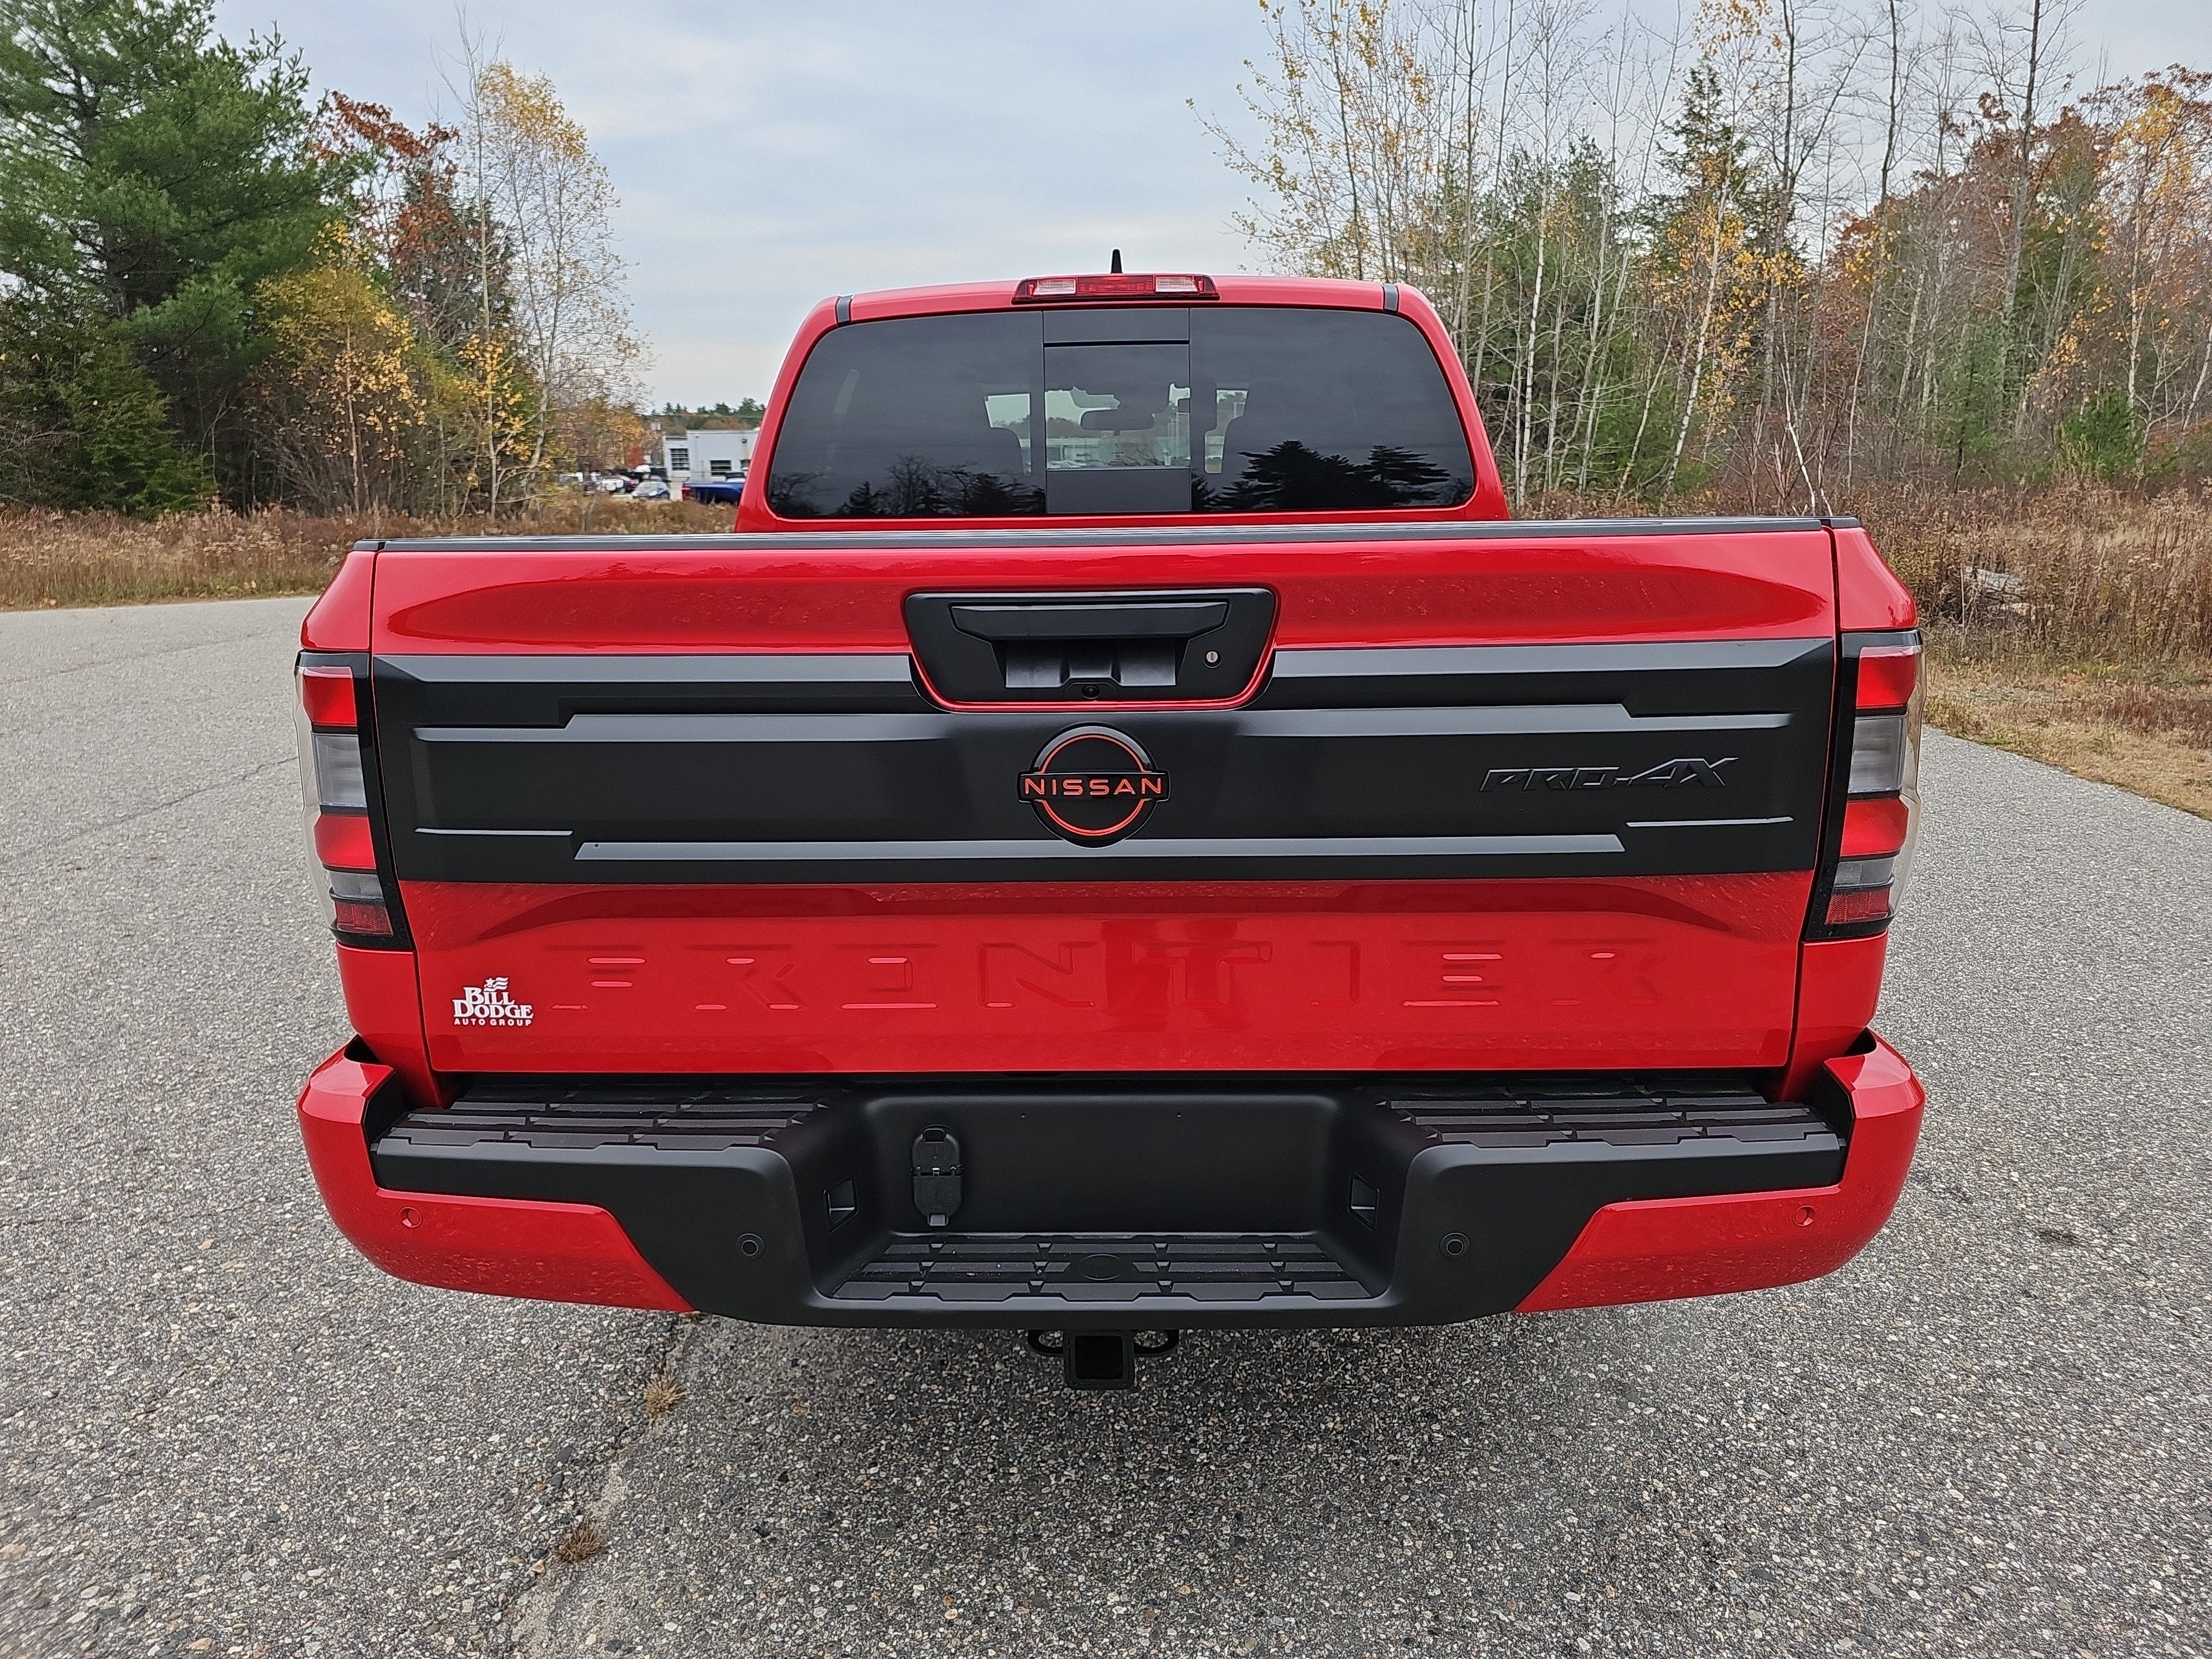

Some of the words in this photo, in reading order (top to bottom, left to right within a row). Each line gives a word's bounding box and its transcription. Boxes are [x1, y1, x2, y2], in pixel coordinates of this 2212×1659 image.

[1478, 756, 1740, 792] PRO-4X
[1024, 777, 1161, 796] NISSAN
[544, 940, 1667, 1010] FRONTIER
[463, 987, 515, 1005] BILL
[452, 999, 534, 1019] DODGE
